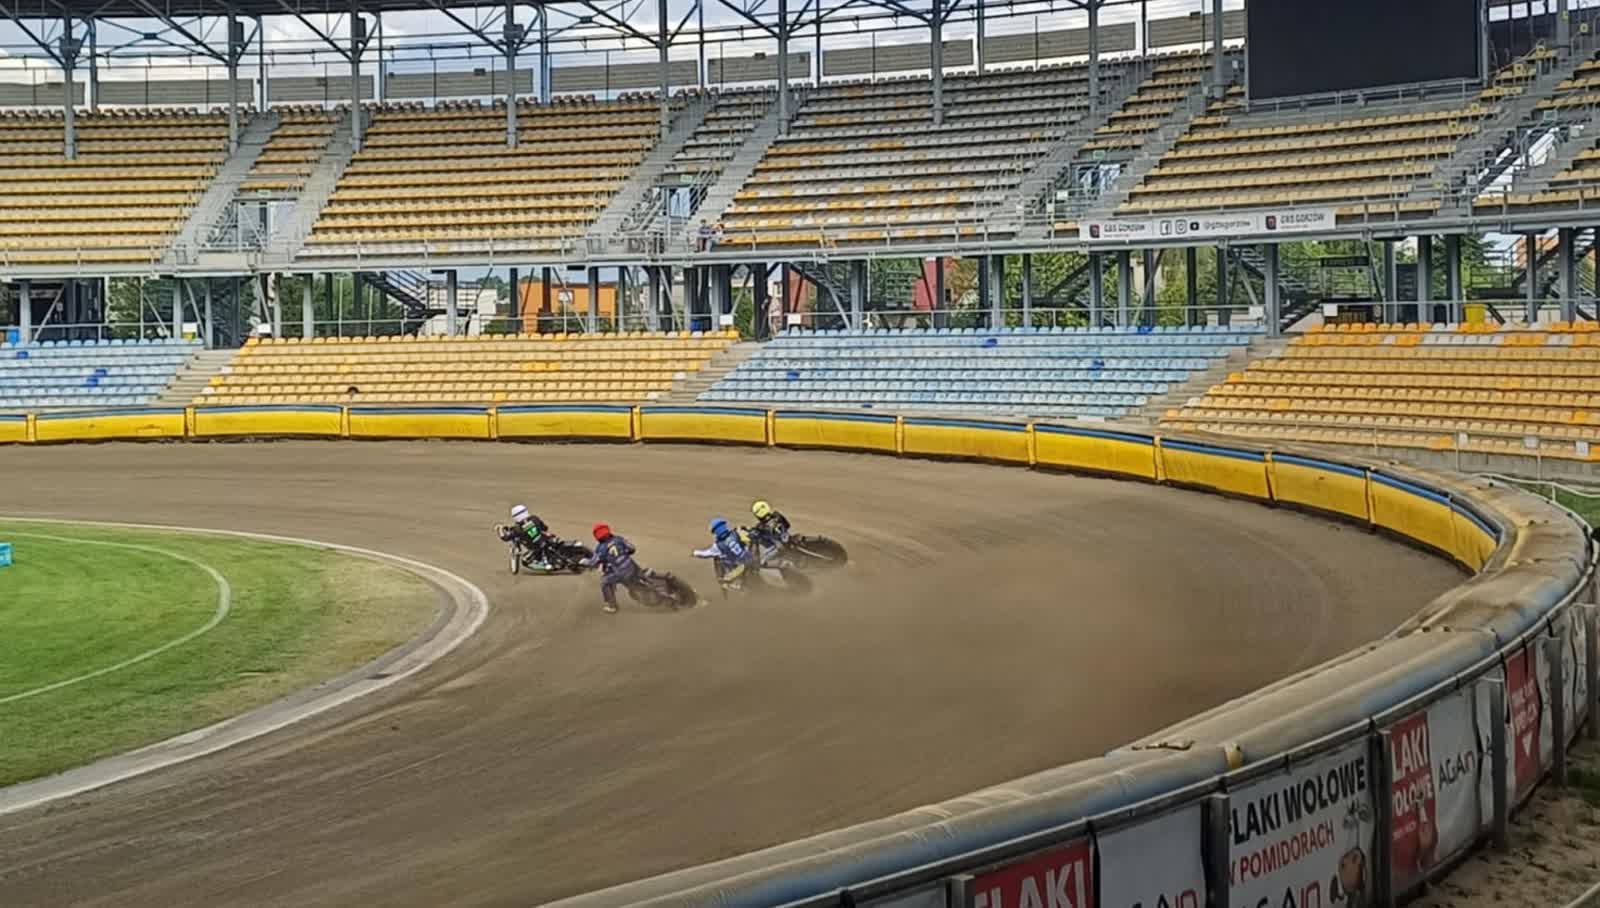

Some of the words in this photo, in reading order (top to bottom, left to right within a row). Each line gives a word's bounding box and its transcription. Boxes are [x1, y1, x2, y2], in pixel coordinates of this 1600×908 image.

[1391, 722, 1430, 783] LAKI
[1228, 791, 1281, 846] LAKI
[1283, 756, 1366, 824] WOŁOWE
[1239, 818, 1335, 884] POMIDORACH
